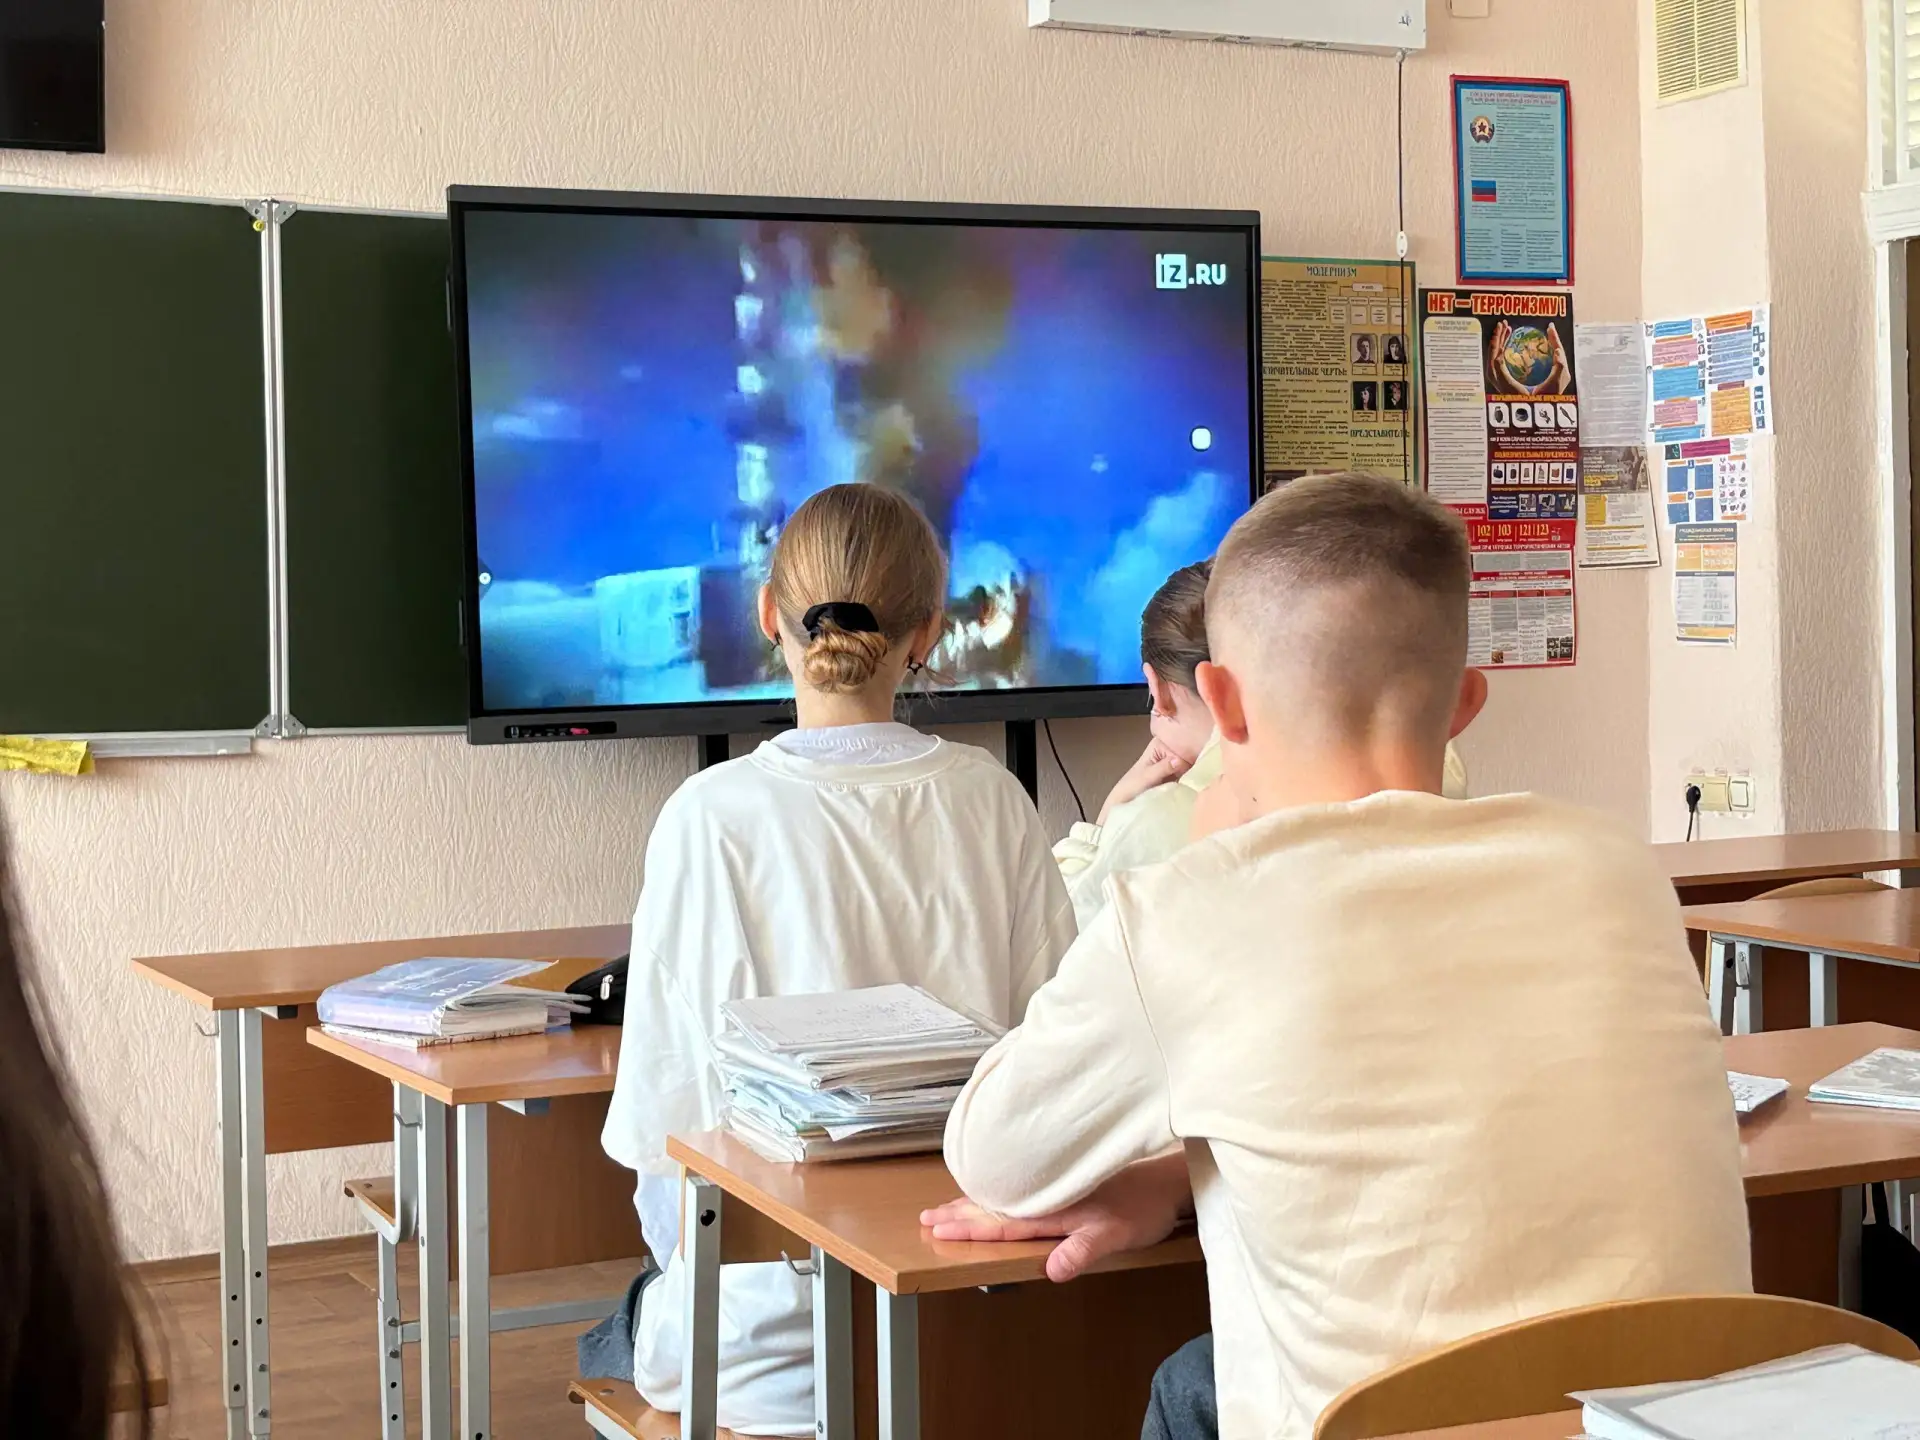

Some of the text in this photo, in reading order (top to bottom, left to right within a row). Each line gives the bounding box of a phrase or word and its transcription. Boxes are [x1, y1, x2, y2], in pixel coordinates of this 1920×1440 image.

[1156, 254, 1227, 289] IZ.RU
[1306, 266, 1357, 277] МОДЕРНИЗМ
[1428, 292, 1456, 314] НЕТ
[1477, 524, 1491, 537] 102
[1498, 524, 1512, 536] 103
